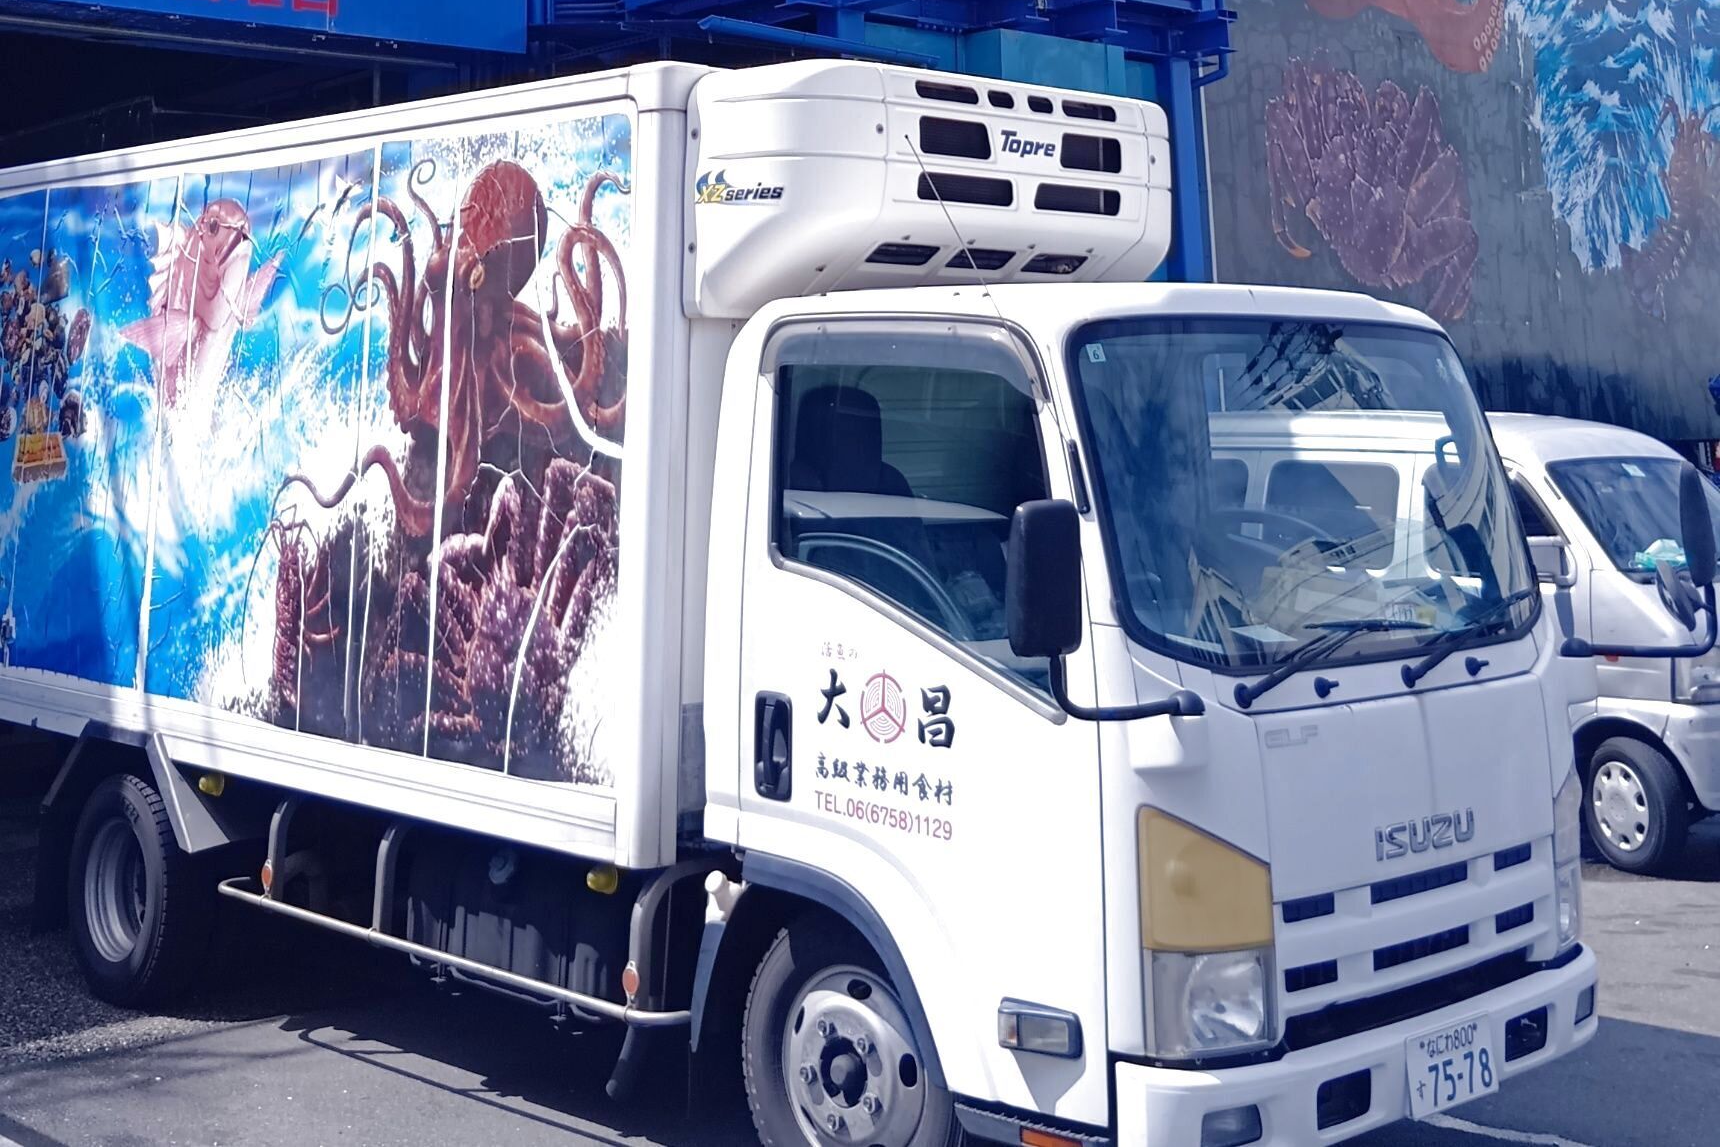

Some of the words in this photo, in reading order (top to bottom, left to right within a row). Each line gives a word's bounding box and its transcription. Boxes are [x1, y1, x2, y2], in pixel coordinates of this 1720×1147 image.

[1000, 129, 1056, 159] Topre
[697, 183, 725, 204] XZ
[725, 182, 784, 201] series
[1092, 349, 1100, 360] 6
[815, 752, 953, 805] 高級業務用食材
[815, 790, 953, 840] TEL.06(6758)1129
[1374, 807, 1475, 862] ISUZU
[1428, 1048, 1492, 1106] 75-78
